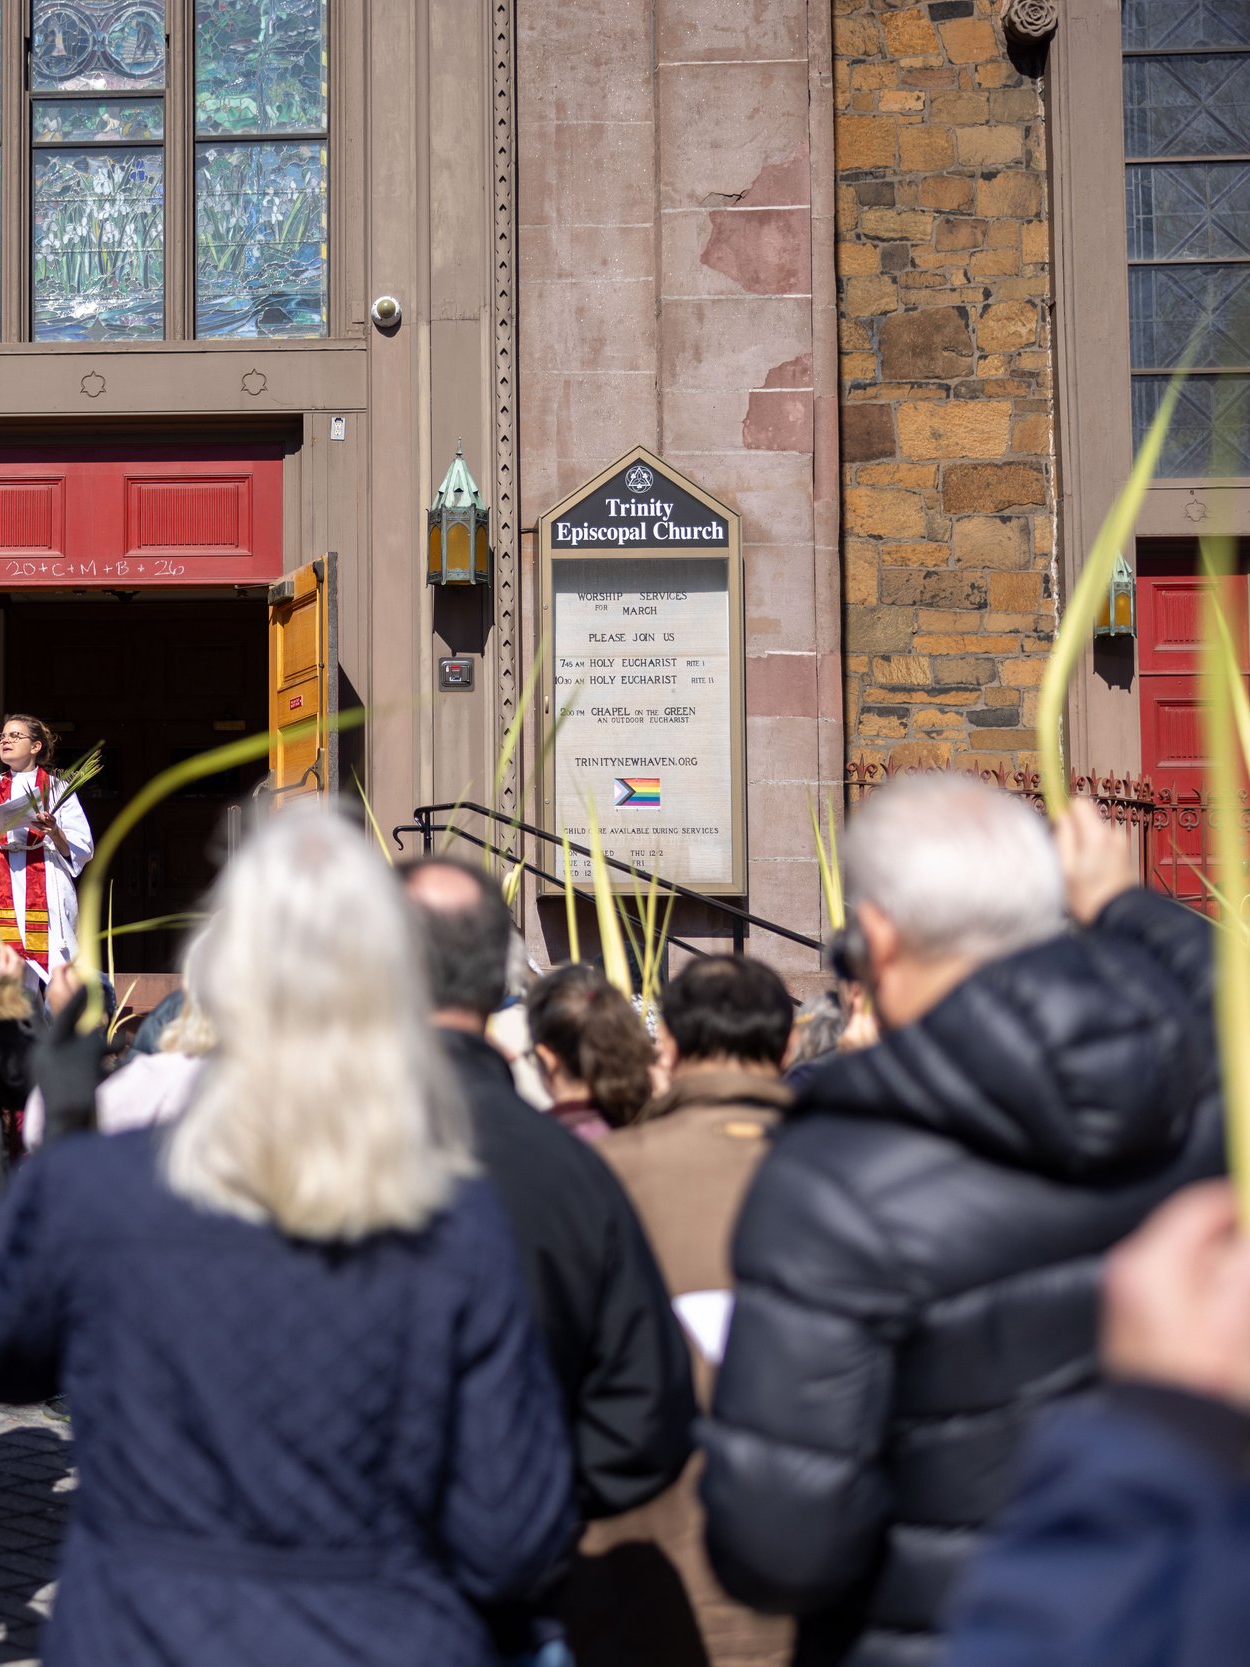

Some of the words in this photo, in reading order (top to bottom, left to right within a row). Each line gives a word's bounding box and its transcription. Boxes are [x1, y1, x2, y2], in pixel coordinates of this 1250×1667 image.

[606, 498, 673, 520] Trinity
[557, 522, 646, 545] Episcopal
[653, 521, 724, 540] Church
[578, 592, 623, 601] WORSHIP
[640, 592, 688, 601] SERVICES
[622, 606, 657, 615] MARCH
[589, 633, 626, 642] PLEASE
[632, 633, 655, 642] JOIN
[663, 633, 675, 641] US
[590, 659, 615, 667] HOLY
[622, 658, 677, 667] EUCHARIST
[590, 676, 616, 685] HOLY
[621, 676, 677, 685] EUCHARIST
[591, 708, 630, 716] CHAPEL
[664, 707, 696, 716] GREEN
[575, 757, 698, 767] TRINITYNEWHAVEN.ORG
